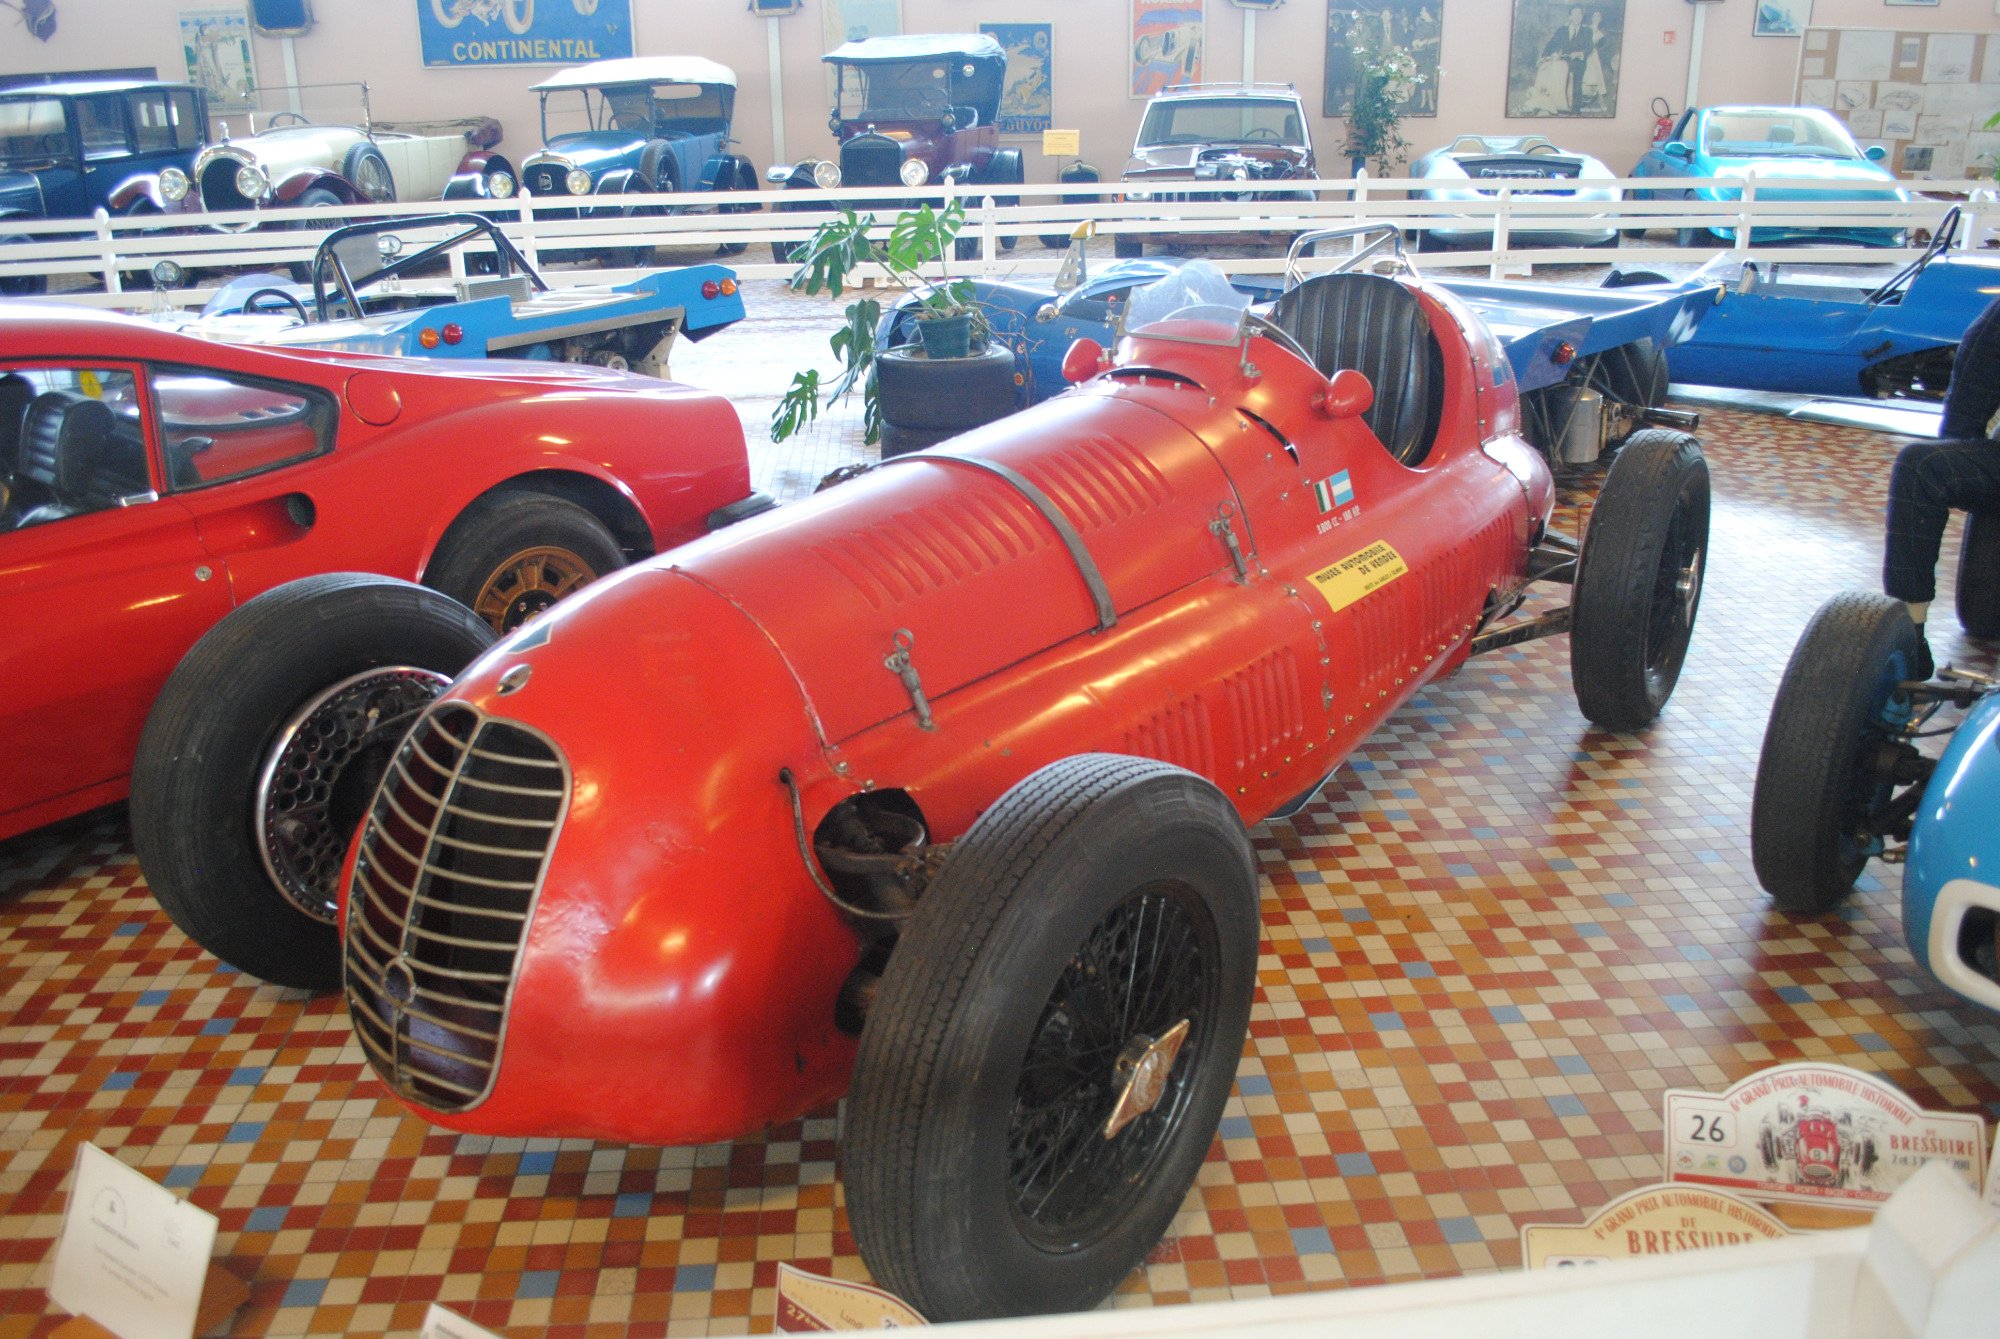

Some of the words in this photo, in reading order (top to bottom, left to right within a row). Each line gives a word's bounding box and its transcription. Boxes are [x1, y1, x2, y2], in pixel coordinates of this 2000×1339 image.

[453, 39, 600, 62] CONTINENTAL
[1007, 119, 1051, 131] GUYOT
[1315, 567, 1342, 584] MUSEE
[1341, 544, 1386, 571] AUTOMOBILE
[1358, 564, 1371, 576] DE
[1370, 550, 1397, 569] VENDEE
[1740, 1082, 1771, 1105] GRAND
[1771, 1075, 1794, 1092] PRIX
[1796, 1073, 1859, 1095] AUTOMOBILE
[1860, 1087, 1915, 1126] HISTORIQUE
[1690, 1114, 1725, 1142] 26
[1890, 1134, 1974, 1157] BRESSUIRE
[1603, 1206, 1635, 1233] GRAND
[1634, 1195, 1660, 1215] PRIX
[1661, 1192, 1724, 1213] AUTOMOBILE
[1681, 1217, 1695, 1228] DE
